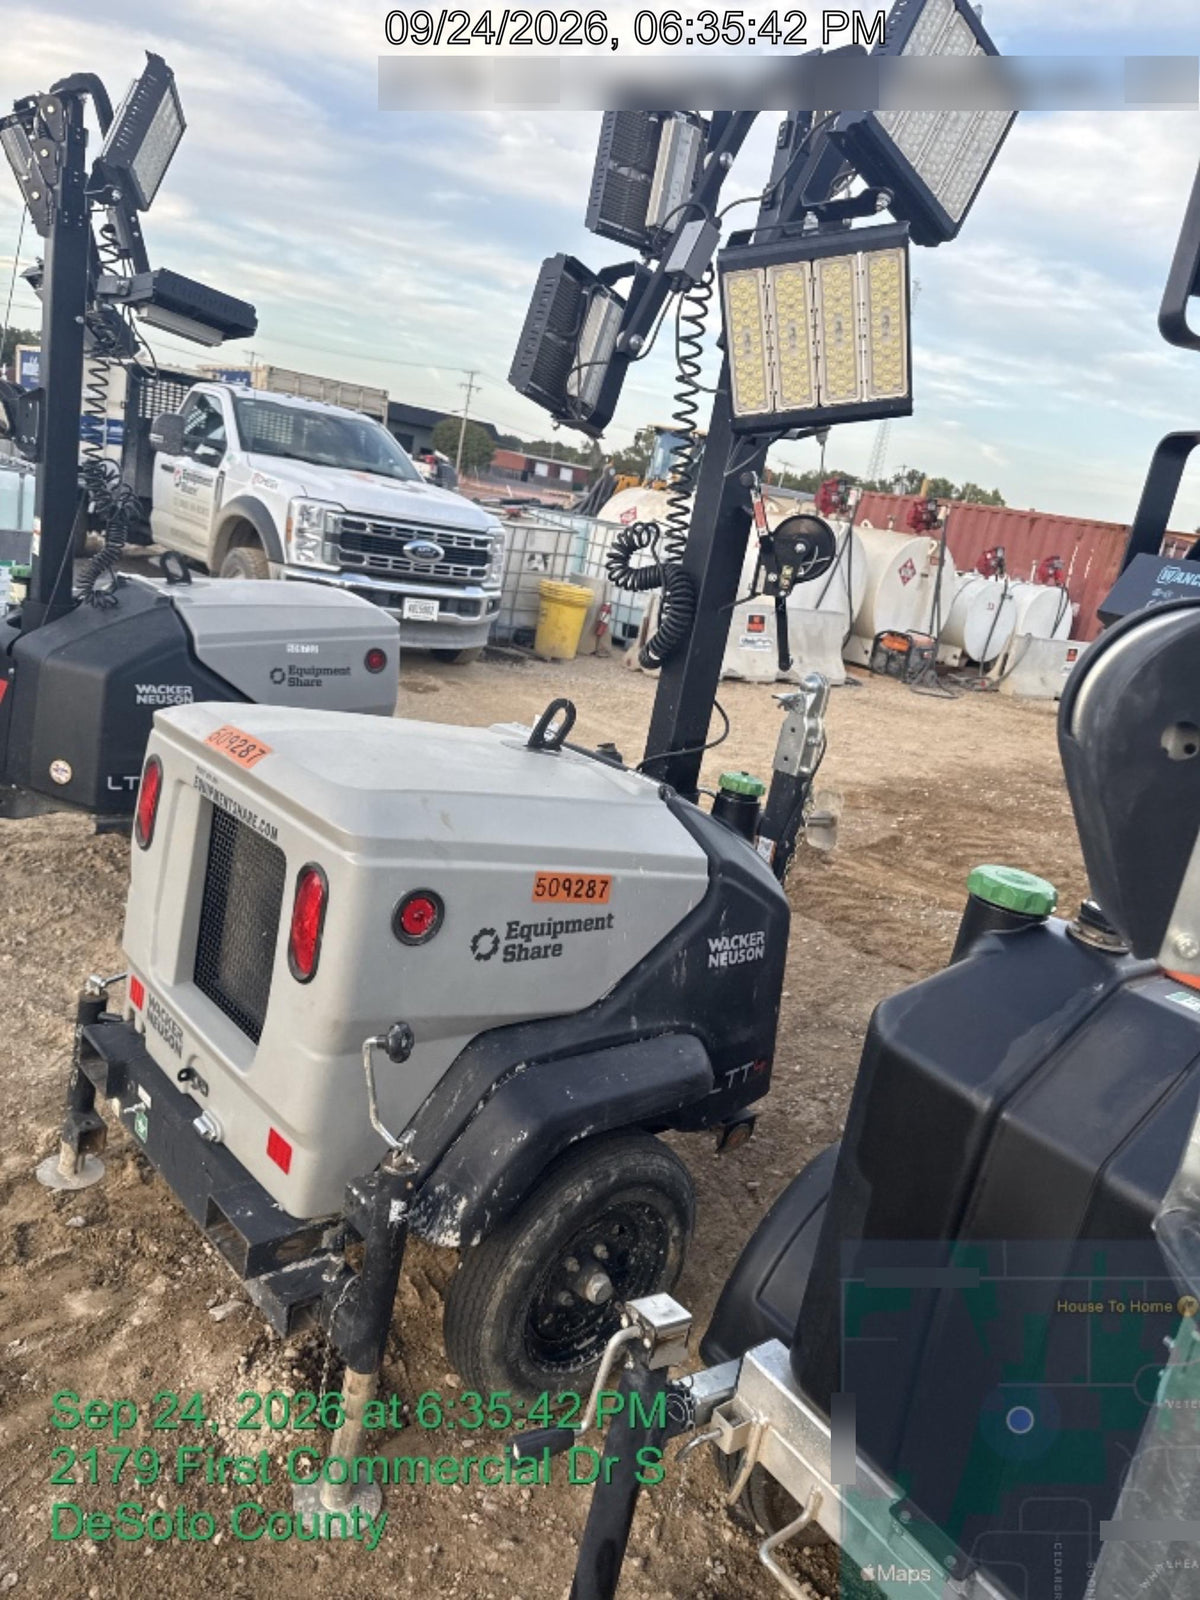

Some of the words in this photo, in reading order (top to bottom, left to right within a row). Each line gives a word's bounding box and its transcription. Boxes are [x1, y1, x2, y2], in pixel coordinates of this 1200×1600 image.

[288, 665, 351, 678] Equipment
[288, 677, 322, 688] Share
[135, 684, 193, 695] WACKER
[136, 694, 193, 705] NEUSON
[208, 727, 267, 763] 509287
[535, 877, 610, 900] 509287
[504, 912, 615, 942] Equipment
[502, 941, 563, 964] Share
[707, 930, 766, 952] WACKER
[707, 945, 766, 968] NEUSON
[149, 992, 183, 1041] WACKER
[147, 1007, 183, 1059] NEUSON
